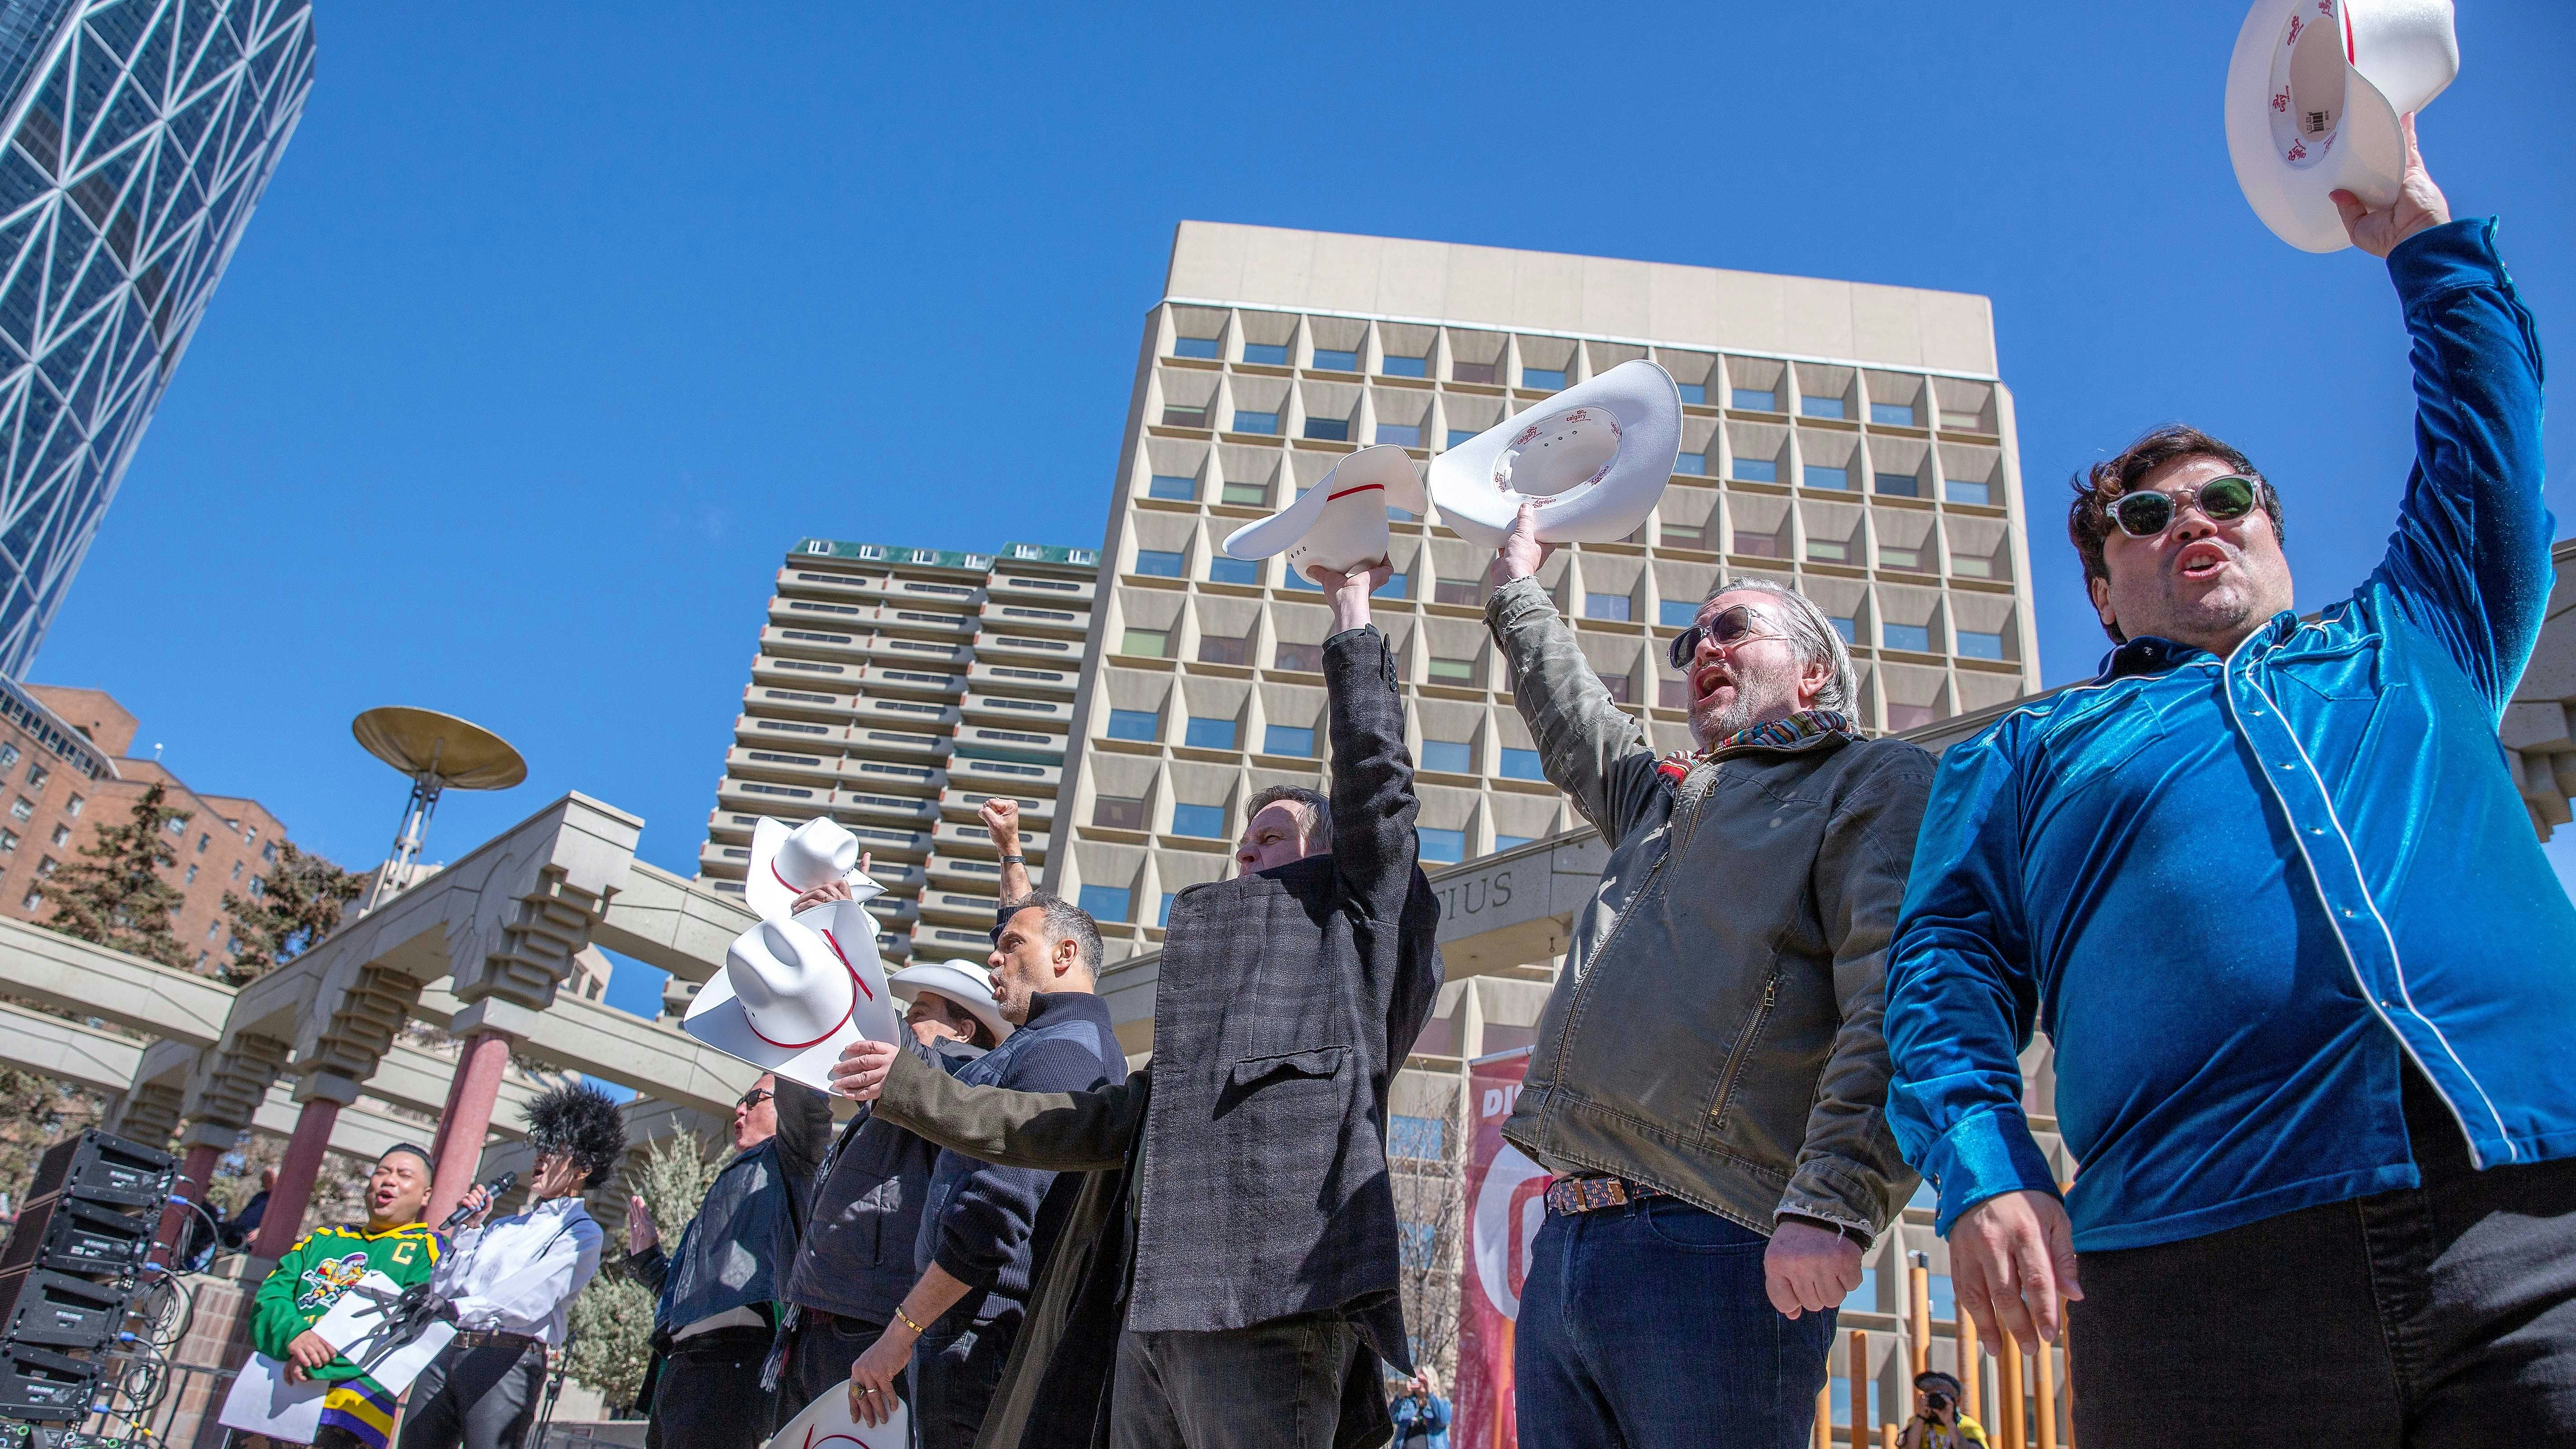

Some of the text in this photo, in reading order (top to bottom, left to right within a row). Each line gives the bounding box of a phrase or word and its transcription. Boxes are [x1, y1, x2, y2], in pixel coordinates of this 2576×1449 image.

[1517, 430, 1536, 445] calgary
[1435, 871, 1511, 920] IUS
[392, 1242, 418, 1265] C
